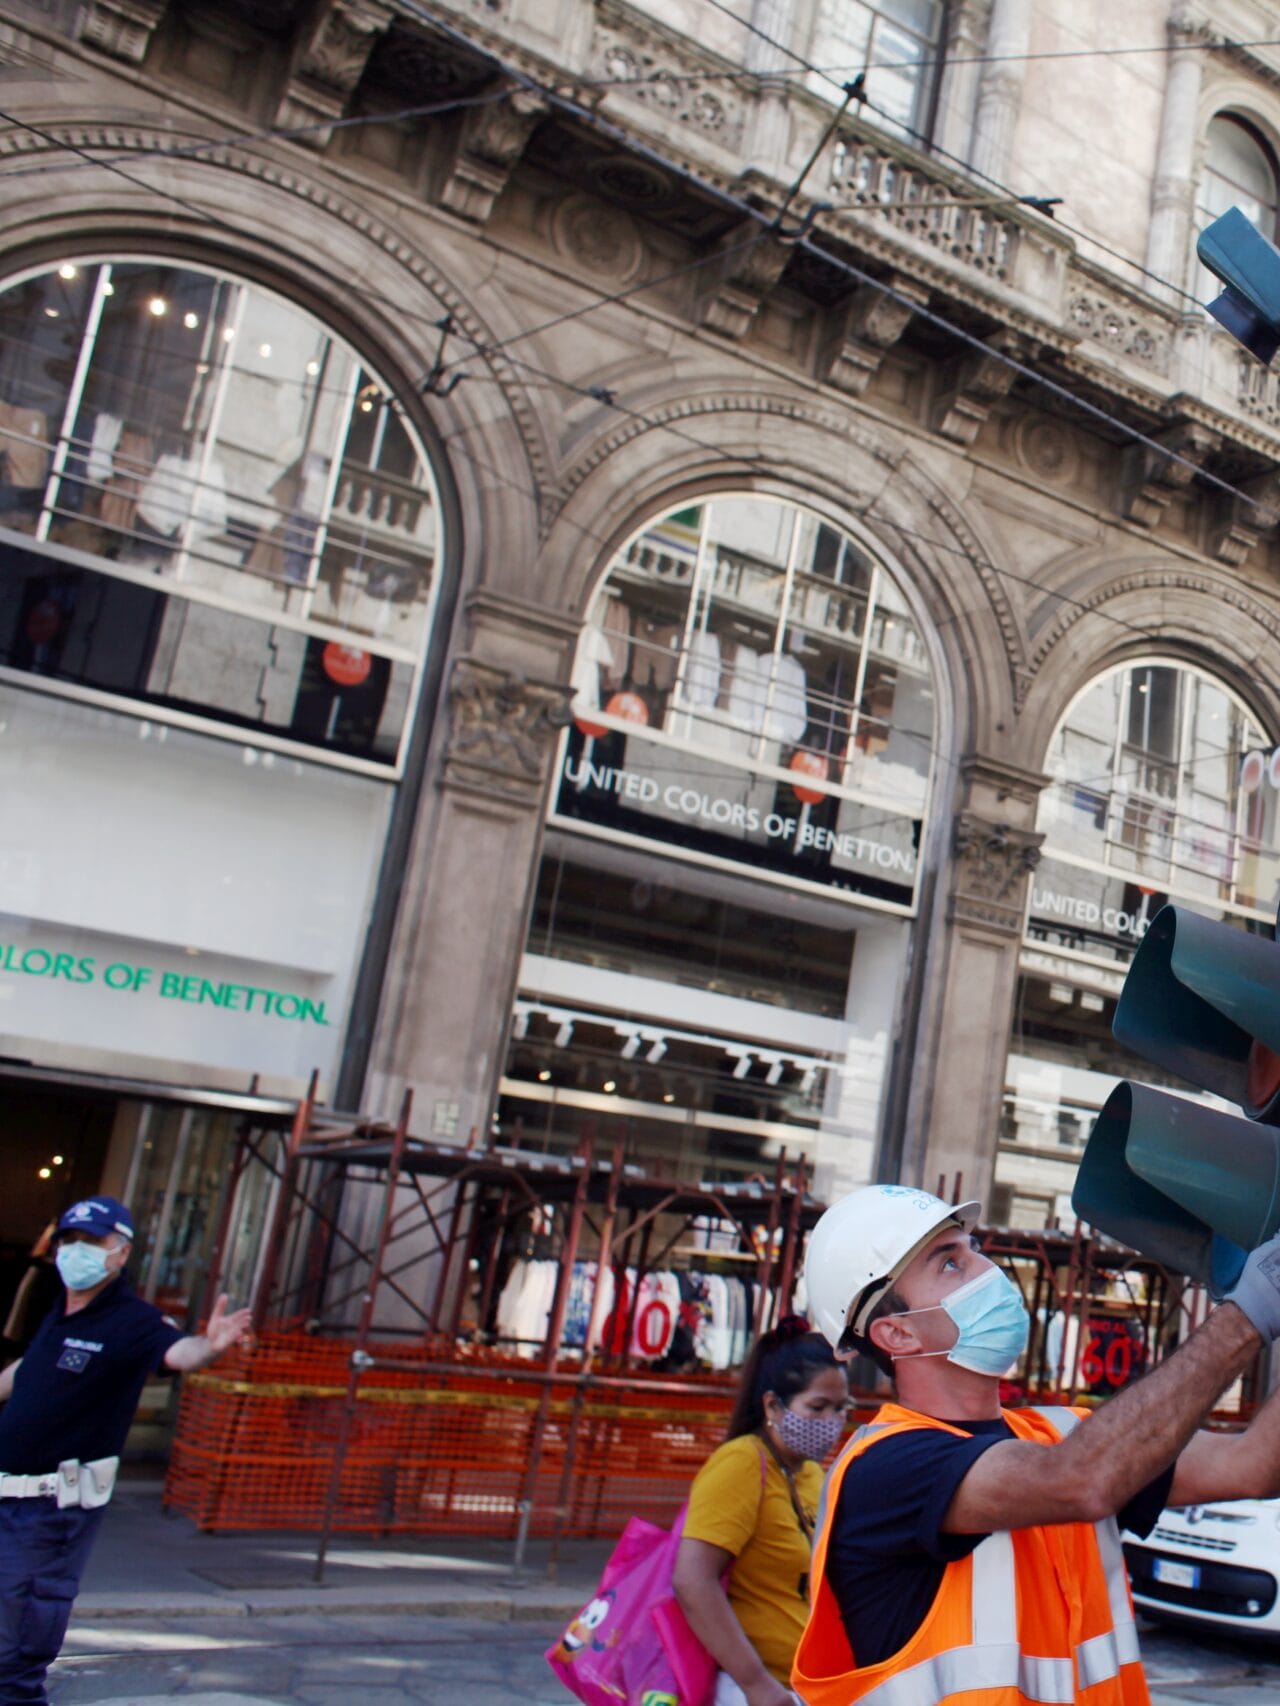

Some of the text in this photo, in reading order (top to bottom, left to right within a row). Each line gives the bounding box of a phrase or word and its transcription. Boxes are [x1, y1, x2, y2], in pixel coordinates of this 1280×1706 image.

[564, 757, 658, 802] UNITED
[663, 786, 759, 831] COLORS
[764, 814, 797, 841] OF
[1032, 888, 1100, 923] UNITED
[103, 962, 153, 992] OF
